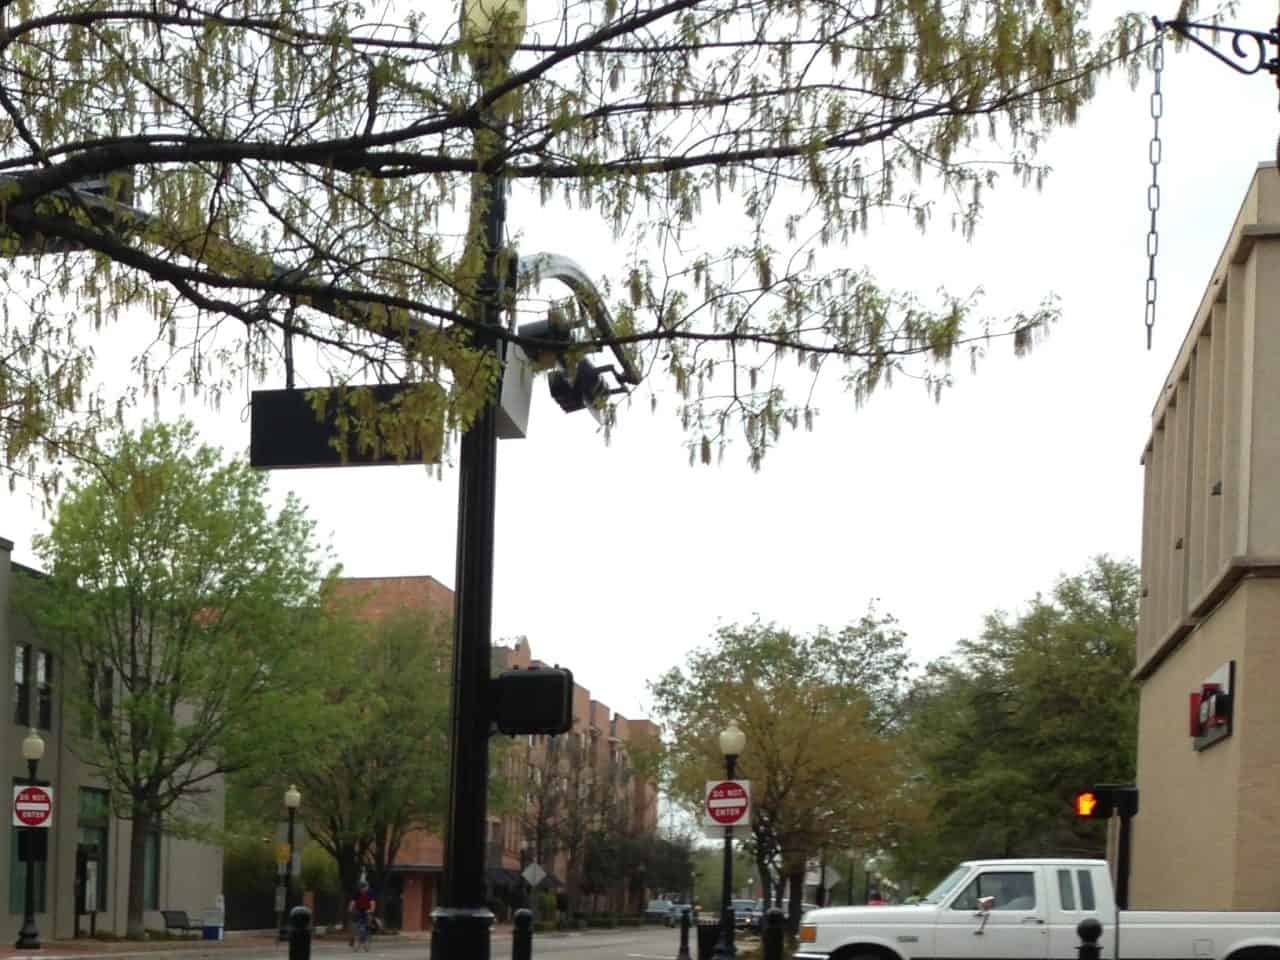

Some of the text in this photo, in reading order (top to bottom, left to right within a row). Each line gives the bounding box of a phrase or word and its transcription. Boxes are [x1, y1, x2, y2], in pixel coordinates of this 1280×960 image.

[20, 793, 45, 801] DO NOT
[712, 788, 742, 798] DO NOT
[22, 811, 45, 819] ENTER
[715, 807, 740, 817] ENTER
